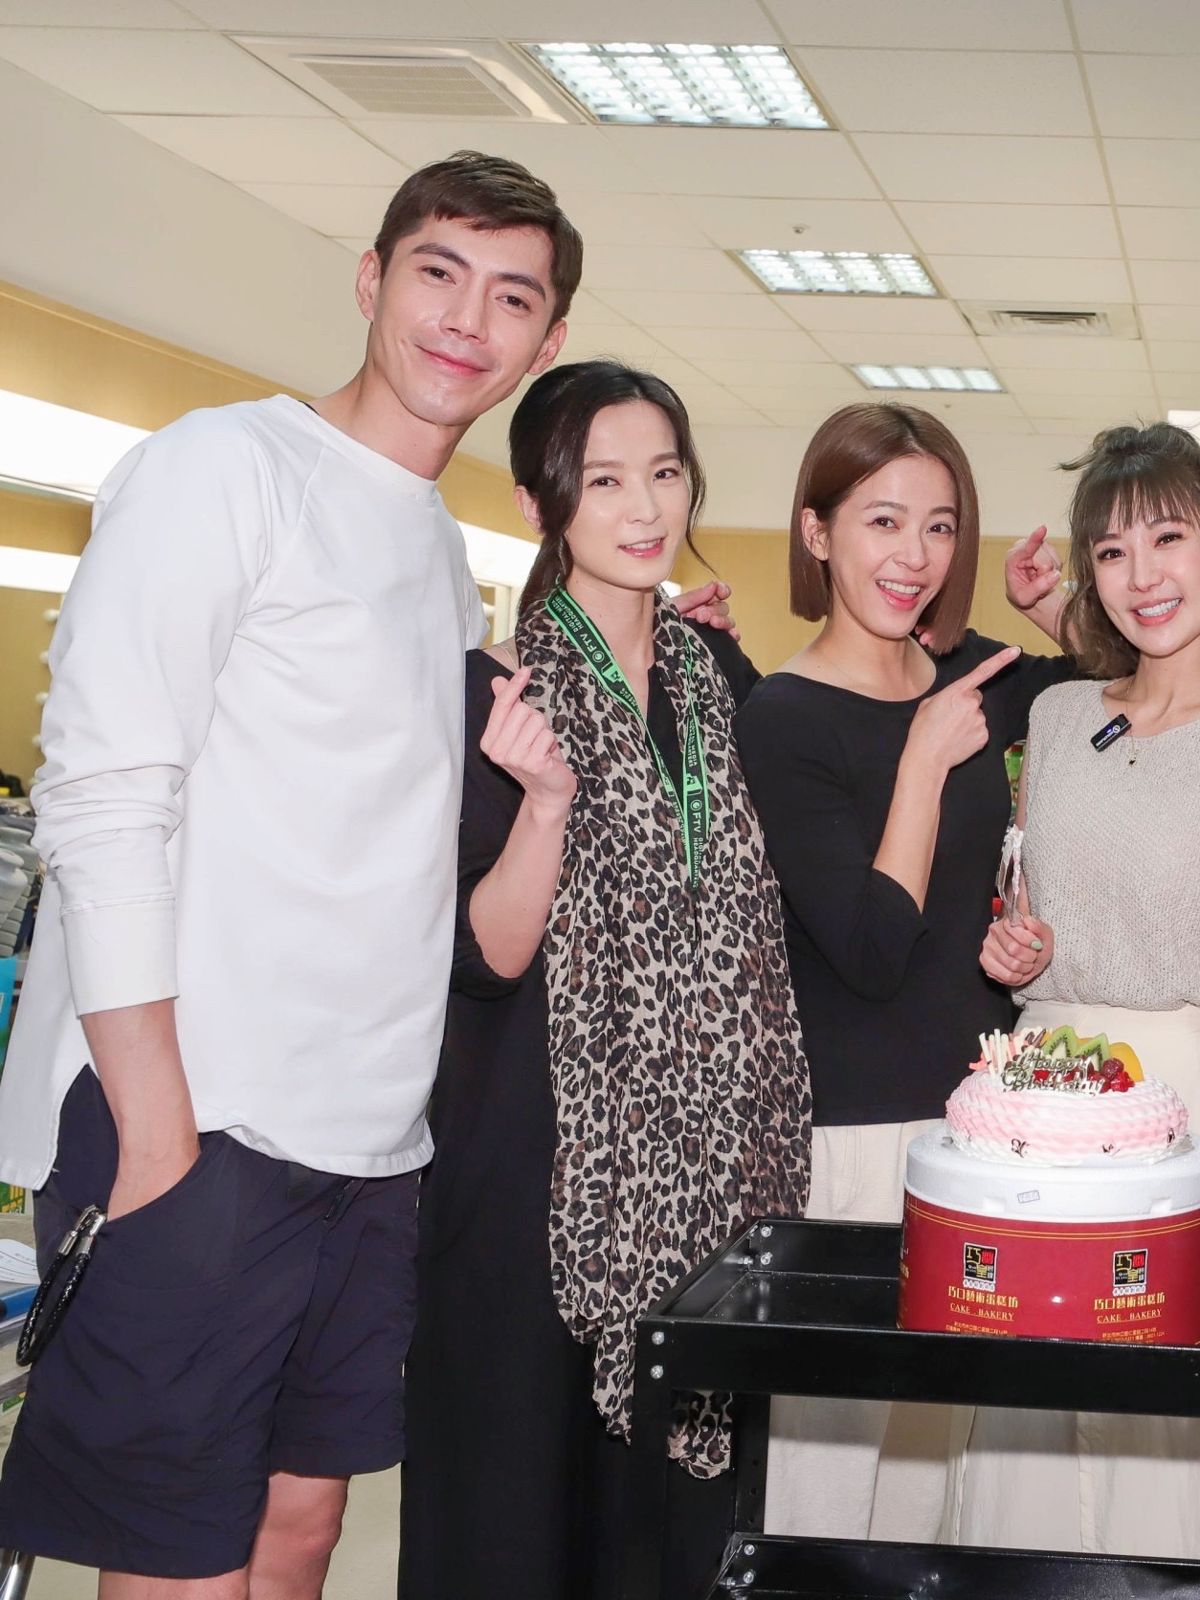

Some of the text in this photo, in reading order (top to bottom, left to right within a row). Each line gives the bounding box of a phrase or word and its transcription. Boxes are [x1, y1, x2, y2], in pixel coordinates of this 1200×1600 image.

[561, 612, 579, 633] DIGITAL
[580, 633, 597, 653] FTV
[692, 813, 702, 833] FTV
[950, 1303, 1015, 1320] CAKE BAKERY
[1096, 1308, 1162, 1323] CAKE BAKERY
